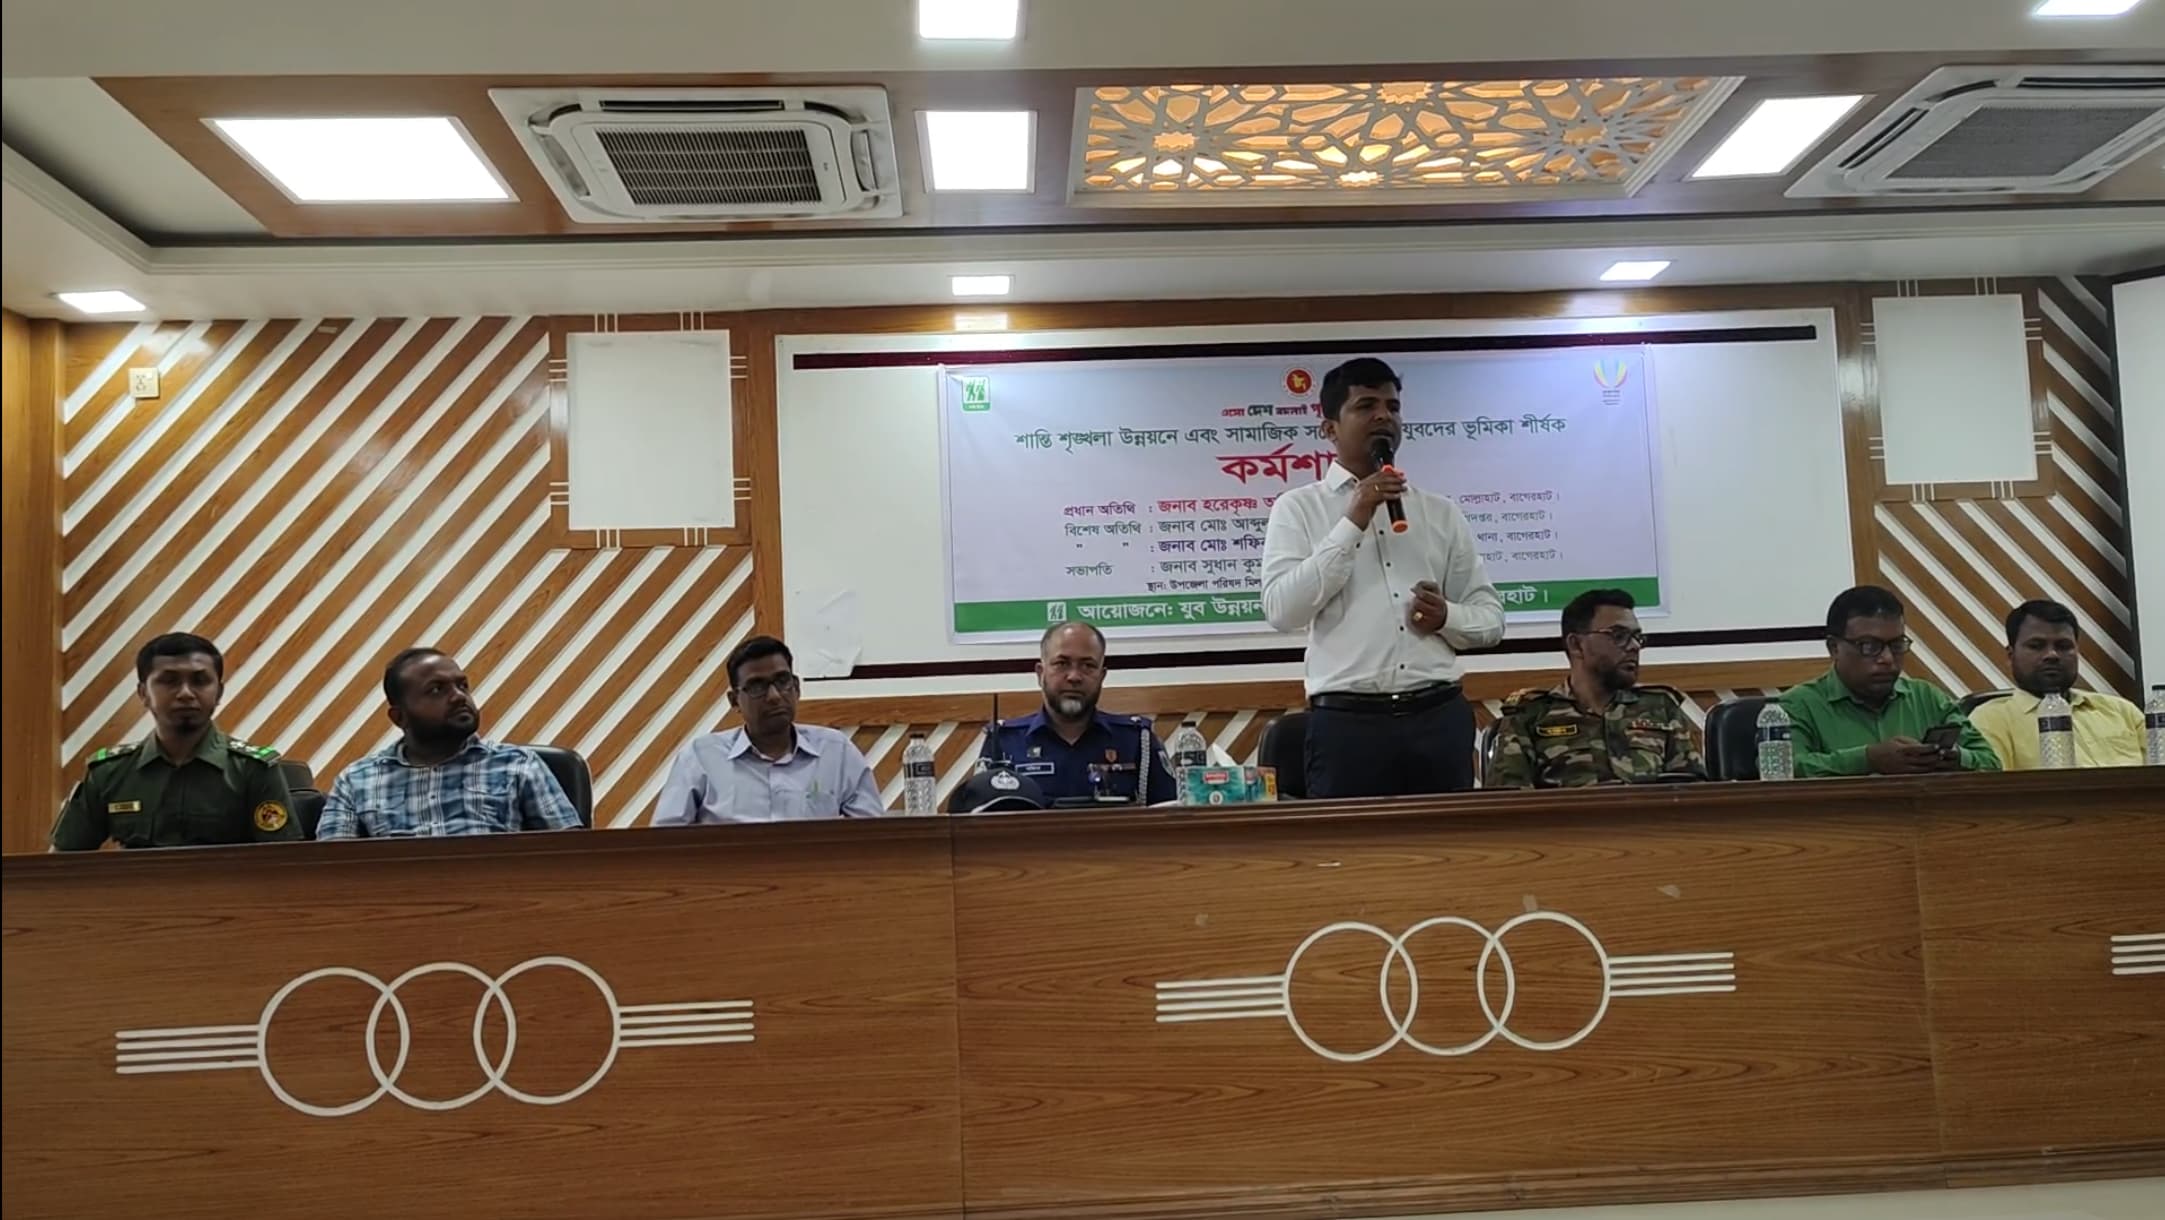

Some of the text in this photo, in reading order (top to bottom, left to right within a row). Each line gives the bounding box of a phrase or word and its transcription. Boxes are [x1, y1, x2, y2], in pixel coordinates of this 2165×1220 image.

[1015, 428, 1053, 449] শান্তি
[1058, 430, 1112, 454] শৃঙ্খলা
[1119, 426, 1178, 447] উন্নয়নে
[1184, 428, 1220, 444] এবং
[1224, 421, 1299, 442] সামাজিক
[1401, 421, 1456, 441] যুবদের
[1461, 415, 1514, 440] ভূমিকা
[1520, 413, 1567, 434] শীর্ষক
[1216, 443, 1337, 484] কর্মশা
[1064, 505, 1094, 517] প্রধান
[1097, 500, 1136, 515] অতিথি
[1157, 499, 1197, 512] জনাব
[1064, 522, 1100, 536] বিশেষ
[1103, 520, 1142, 535] অতিথি
[1158, 519, 1196, 533] জনাব
[1200, 519, 1228, 532] মোঃ
[1157, 539, 1196, 553] জনাব
[1200, 538, 1228, 552] মোঃ
[1231, 533, 1265, 550] শফি
[1065, 561, 1114, 576] সভাপতি
[1159, 560, 1198, 573] জনাব
[1168, 579, 1208, 590] উপজেলা
[1178, 600, 1206, 620] যুব
